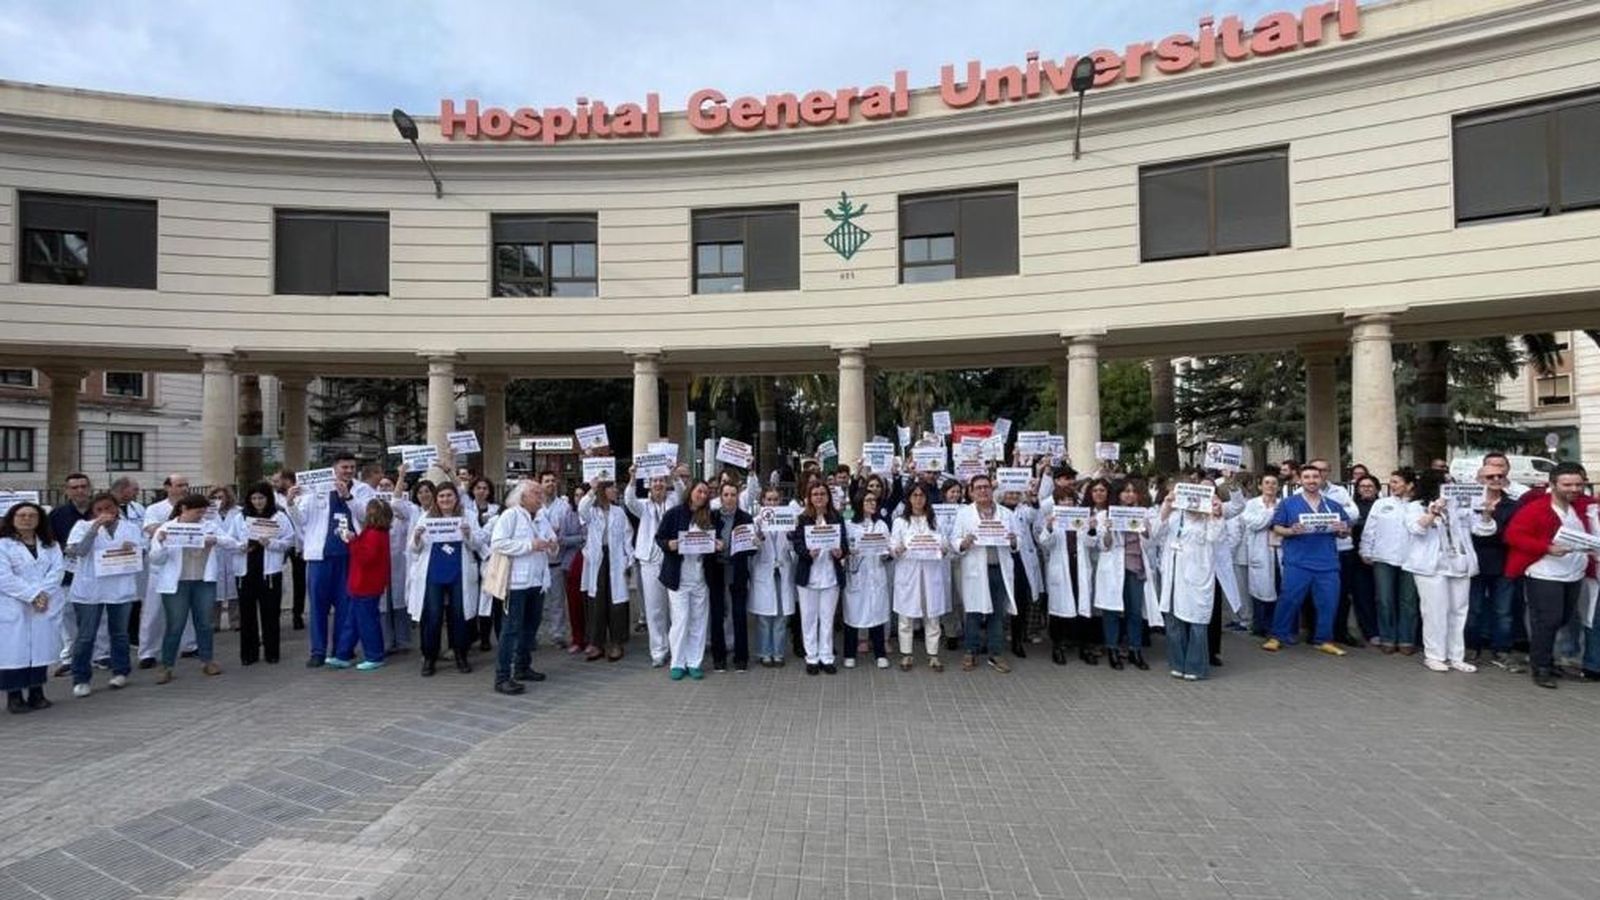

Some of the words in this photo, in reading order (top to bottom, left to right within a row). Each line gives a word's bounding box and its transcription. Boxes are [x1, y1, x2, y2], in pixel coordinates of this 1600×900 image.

[440, 94, 661, 143] Hospital
[687, 72, 910, 132] General
[941, 0, 1361, 108] Universitari
